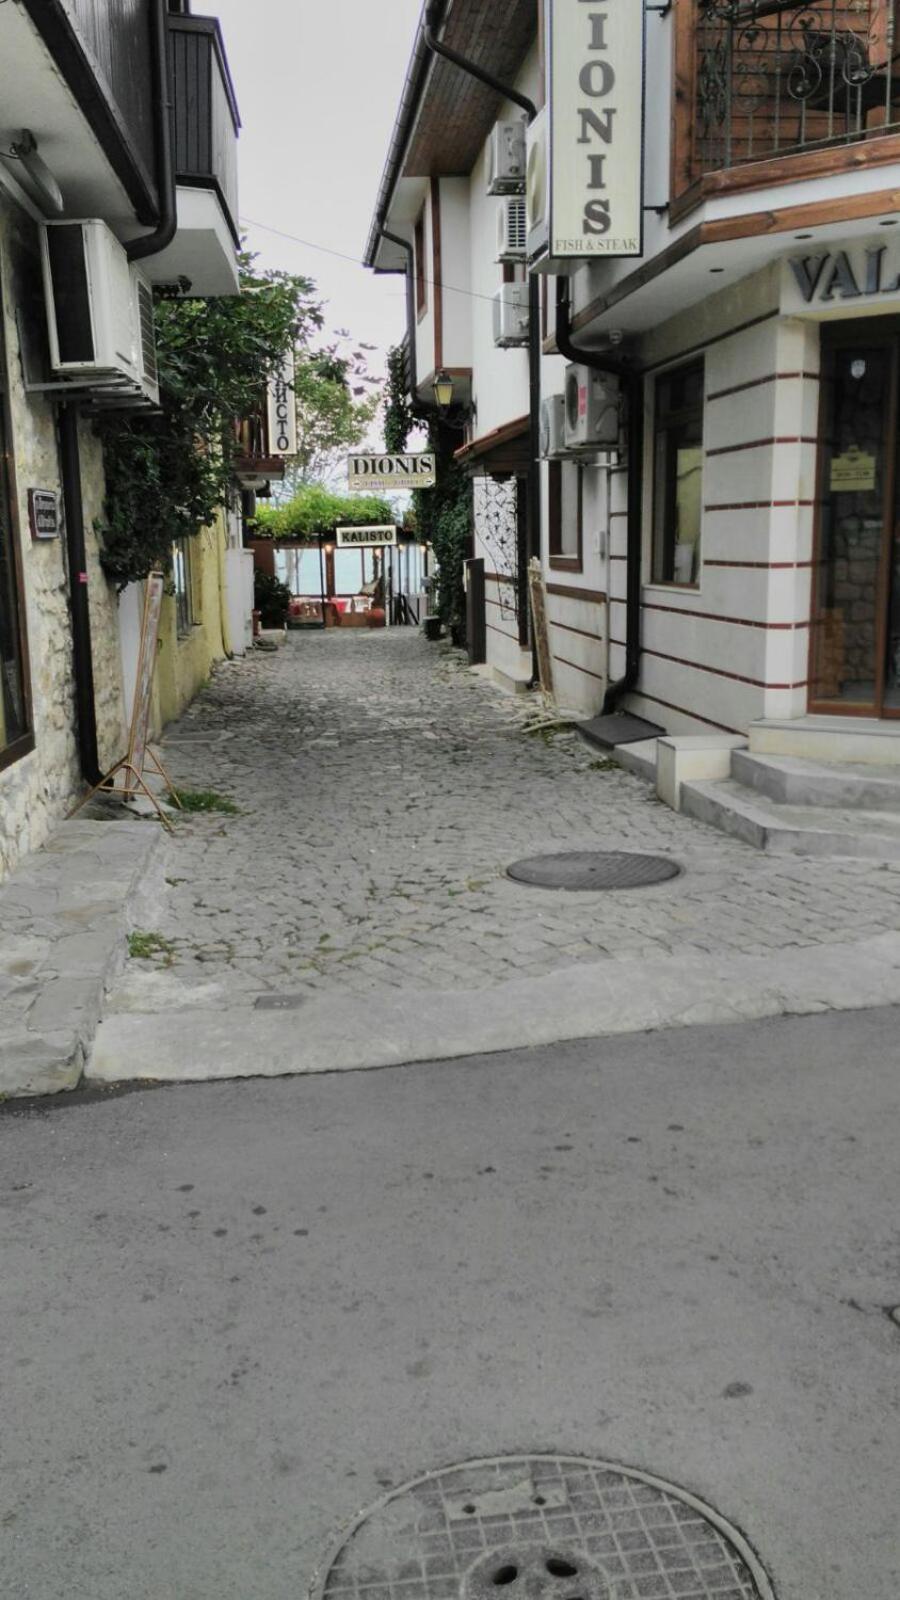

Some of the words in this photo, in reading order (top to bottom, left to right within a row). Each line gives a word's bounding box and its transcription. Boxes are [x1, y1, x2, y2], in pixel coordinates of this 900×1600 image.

[577, 0, 617, 235] IONIS
[555, 240, 584, 251] FISH
[585, 239, 594, 250] &
[597, 238, 638, 250] STEAK
[352, 456, 433, 475] DIONIS
[341, 530, 393, 542] KALISTO
